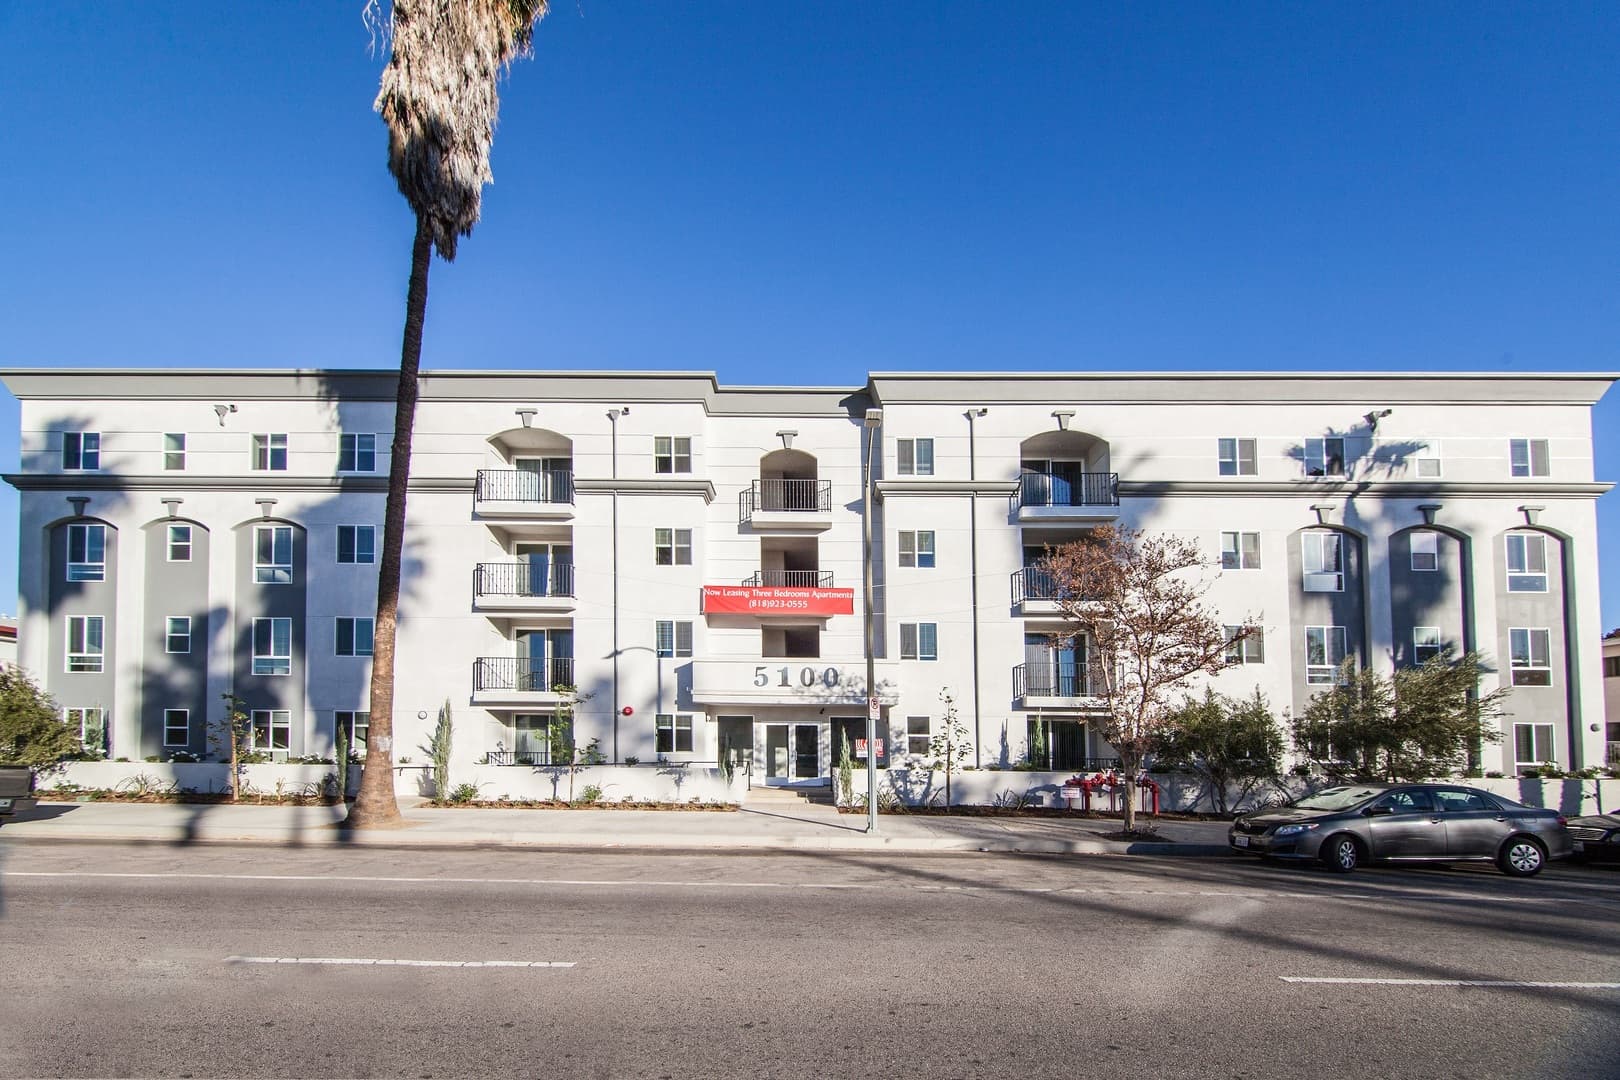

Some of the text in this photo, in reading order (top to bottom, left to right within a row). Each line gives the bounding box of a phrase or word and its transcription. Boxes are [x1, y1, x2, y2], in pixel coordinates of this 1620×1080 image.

[705, 588, 721, 596] Now
[723, 588, 750, 599] Leasing
[752, 589, 772, 597] Three
[774, 589, 809, 598] Bedrooms
[748, 599, 808, 609] (818)923-0555
[753, 666, 839, 688] 5100
